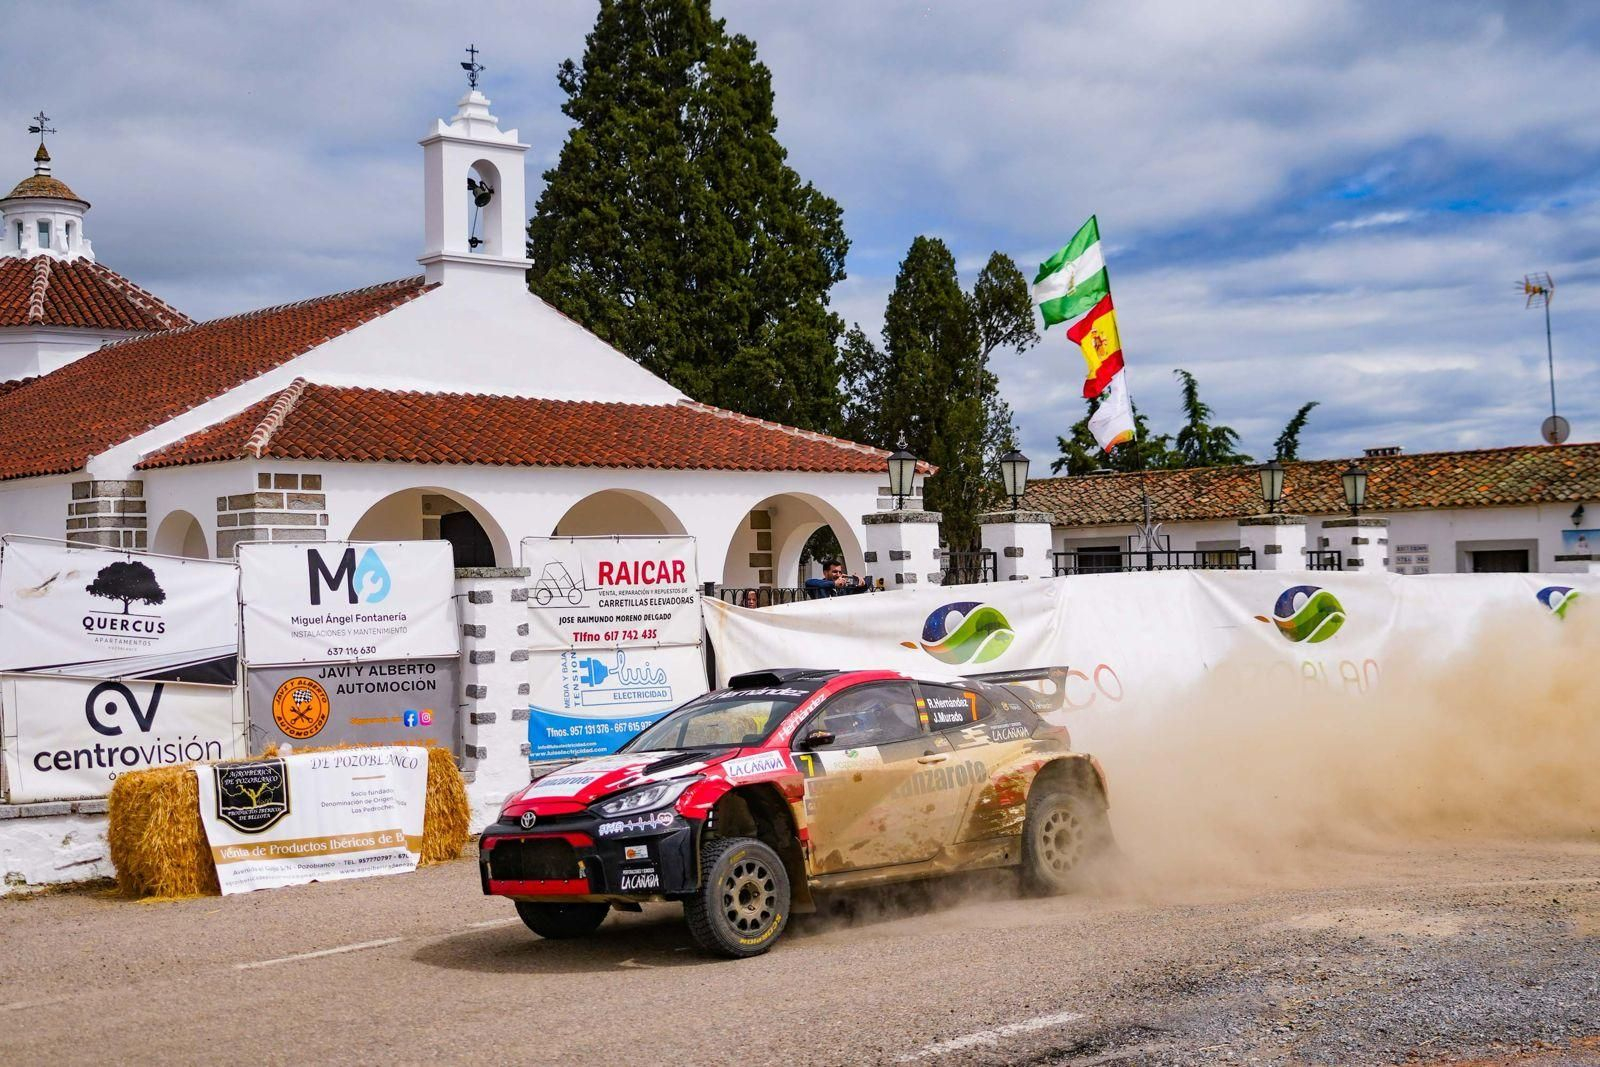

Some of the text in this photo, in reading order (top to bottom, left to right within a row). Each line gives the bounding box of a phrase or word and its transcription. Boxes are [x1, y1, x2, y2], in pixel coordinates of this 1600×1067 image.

[598, 560, 686, 586] RAICAR
[618, 588, 649, 596] REPARACIÓN
[599, 596, 694, 608] CARRETILLAS ELEVADORAS
[82, 616, 165, 634] QUERCUS
[291, 612, 407, 627] Miguel Ángel Fontanería
[558, 613, 672, 625] JOSE RAIMUNDO MORENO DELGADO
[291, 629, 346, 638] INSTALACIONES
[353, 626, 408, 636] MANTENIMIENTO
[604, 631, 619, 641] 617
[622, 630, 639, 640] 742
[641, 629, 657, 639] 435
[94, 637, 152, 647] APARTAMENTOS
[327, 646, 377, 656] 637 116 630
[561, 651, 569, 673] BAJA
[318, 663, 436, 679] JAVI Y ALBERTO
[336, 677, 437, 695] AUTOMOCIÓN
[613, 690, 668, 700] ELECTRICIDAD
[963, 691, 977, 721] 7
[933, 711, 964, 723] J.Murado
[570, 726, 583, 736] 957
[584, 725, 597, 735] 131
[597, 724, 609, 734] 376
[614, 722, 627, 733] 667
[628, 721, 640, 731] 615
[33, 735, 222, 772] centrovisión
[311, 753, 419, 770] DE POZOBLANCO
[800, 755, 815, 777] 7
[729, 765, 743, 777] LA
[368, 788, 394, 796] fundado
[321, 798, 363, 808] Denominación
[251, 845, 267, 857] de
[270, 842, 327, 855] Productos
[330, 833, 376, 850] Ibéricos
[378, 833, 392, 844] de
[297, 861, 335, 870] Pozoblanco
[358, 854, 392, 864] 957770797
[621, 875, 631, 889] LA
